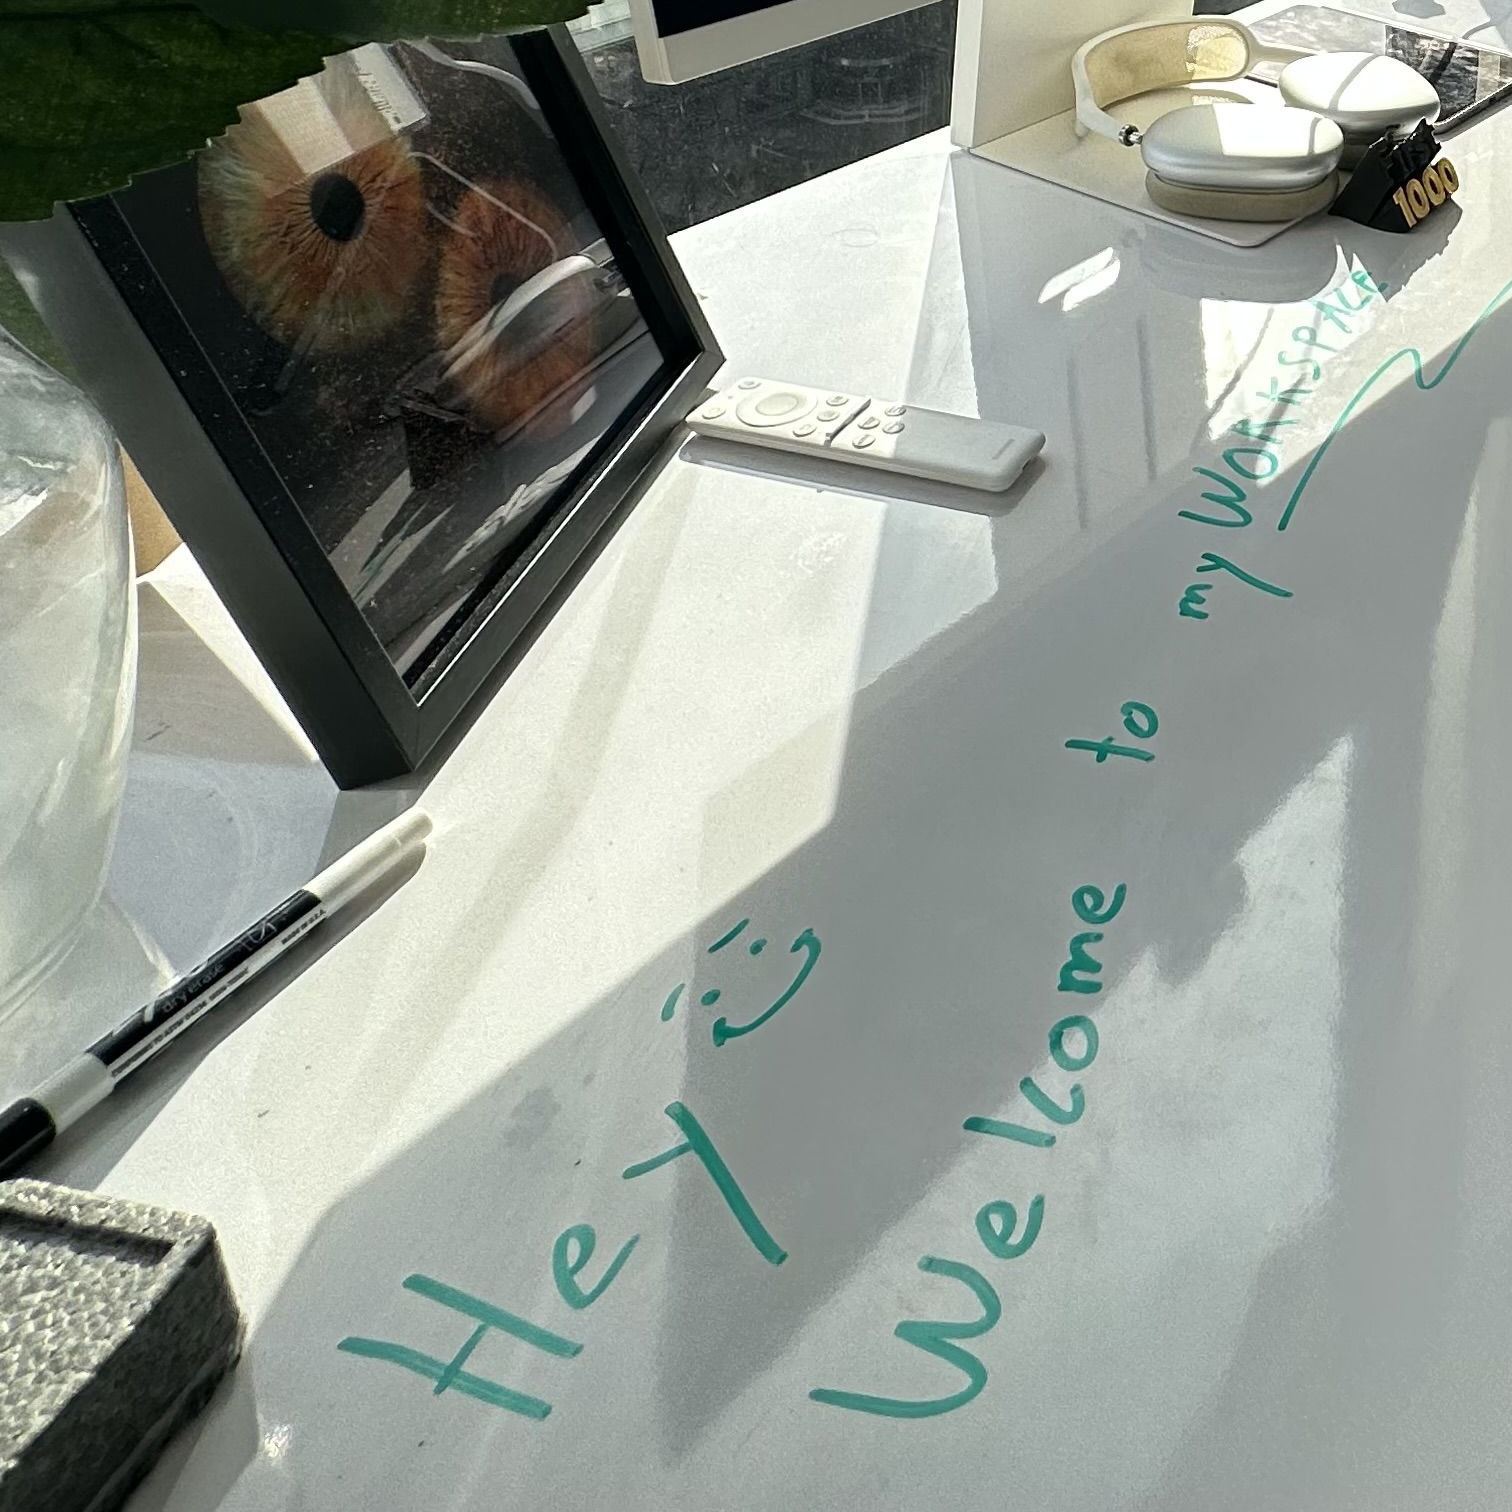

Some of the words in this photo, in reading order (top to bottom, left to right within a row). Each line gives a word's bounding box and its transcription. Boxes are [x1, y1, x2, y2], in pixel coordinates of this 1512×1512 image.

[1392, 157, 1460, 228] 1000
[162, 990, 188, 1014] dry
[808, 883, 1127, 1419] Welcome
[1065, 701, 1159, 763] to
[1179, 552, 1294, 620] my
